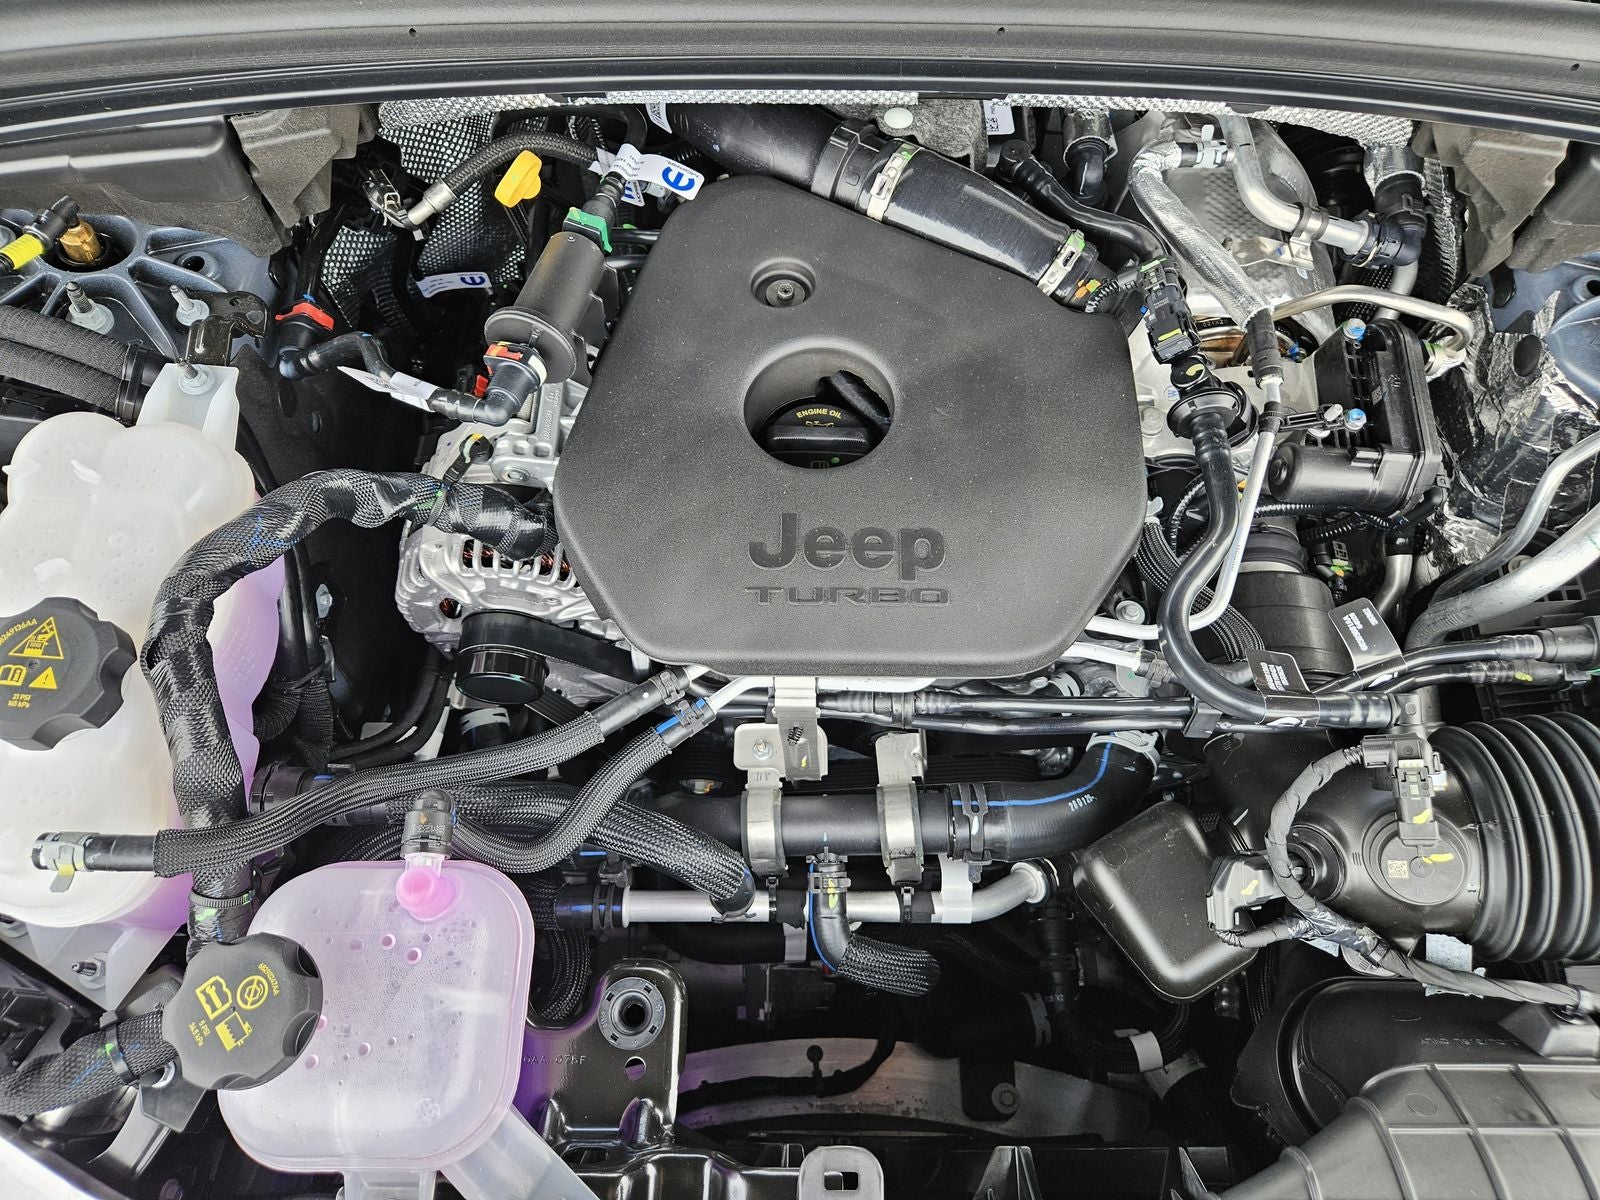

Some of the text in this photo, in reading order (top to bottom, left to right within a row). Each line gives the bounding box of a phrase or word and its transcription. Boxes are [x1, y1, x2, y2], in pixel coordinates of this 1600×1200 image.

[796, 408, 842, 419] ENGINE OIL
[749, 512, 946, 583] Jeep
[745, 587, 950, 605] TURBO
[20, 694, 32, 702] PSI
